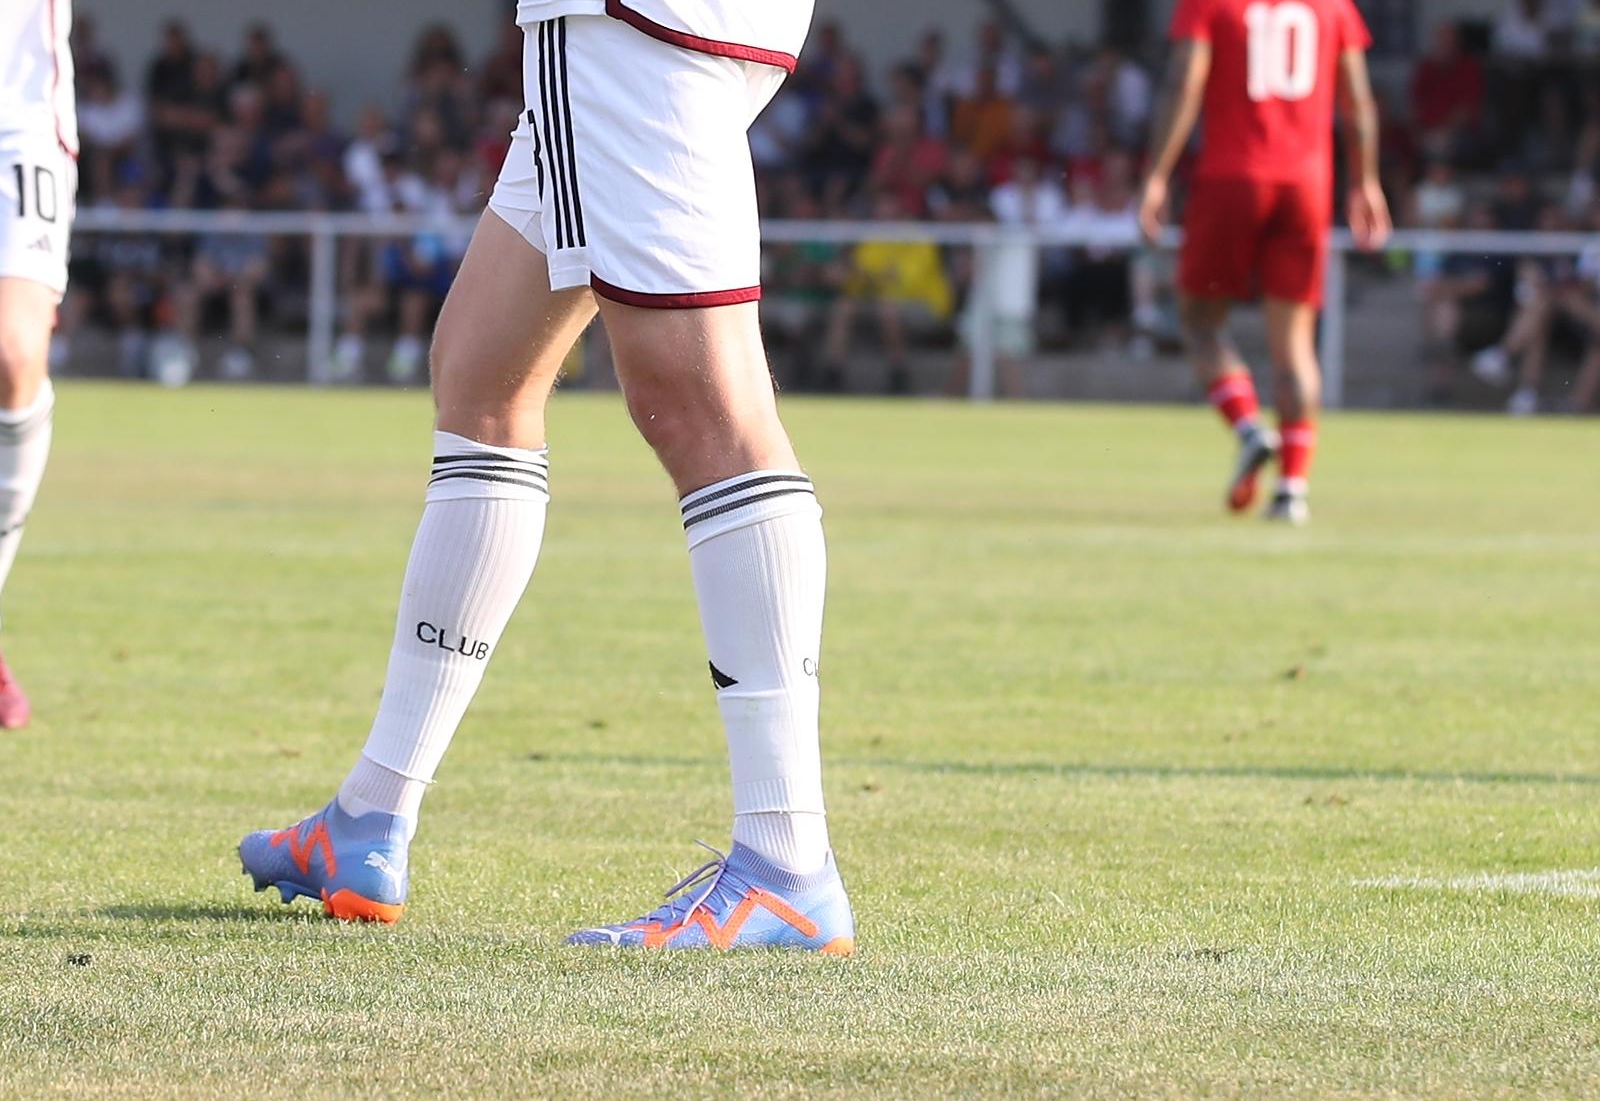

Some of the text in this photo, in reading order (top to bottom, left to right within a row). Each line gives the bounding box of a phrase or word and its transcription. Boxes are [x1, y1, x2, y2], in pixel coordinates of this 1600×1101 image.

[1243, 0, 1320, 102] 10
[12, 164, 57, 224] 10
[416, 621, 490, 661] CLUB
